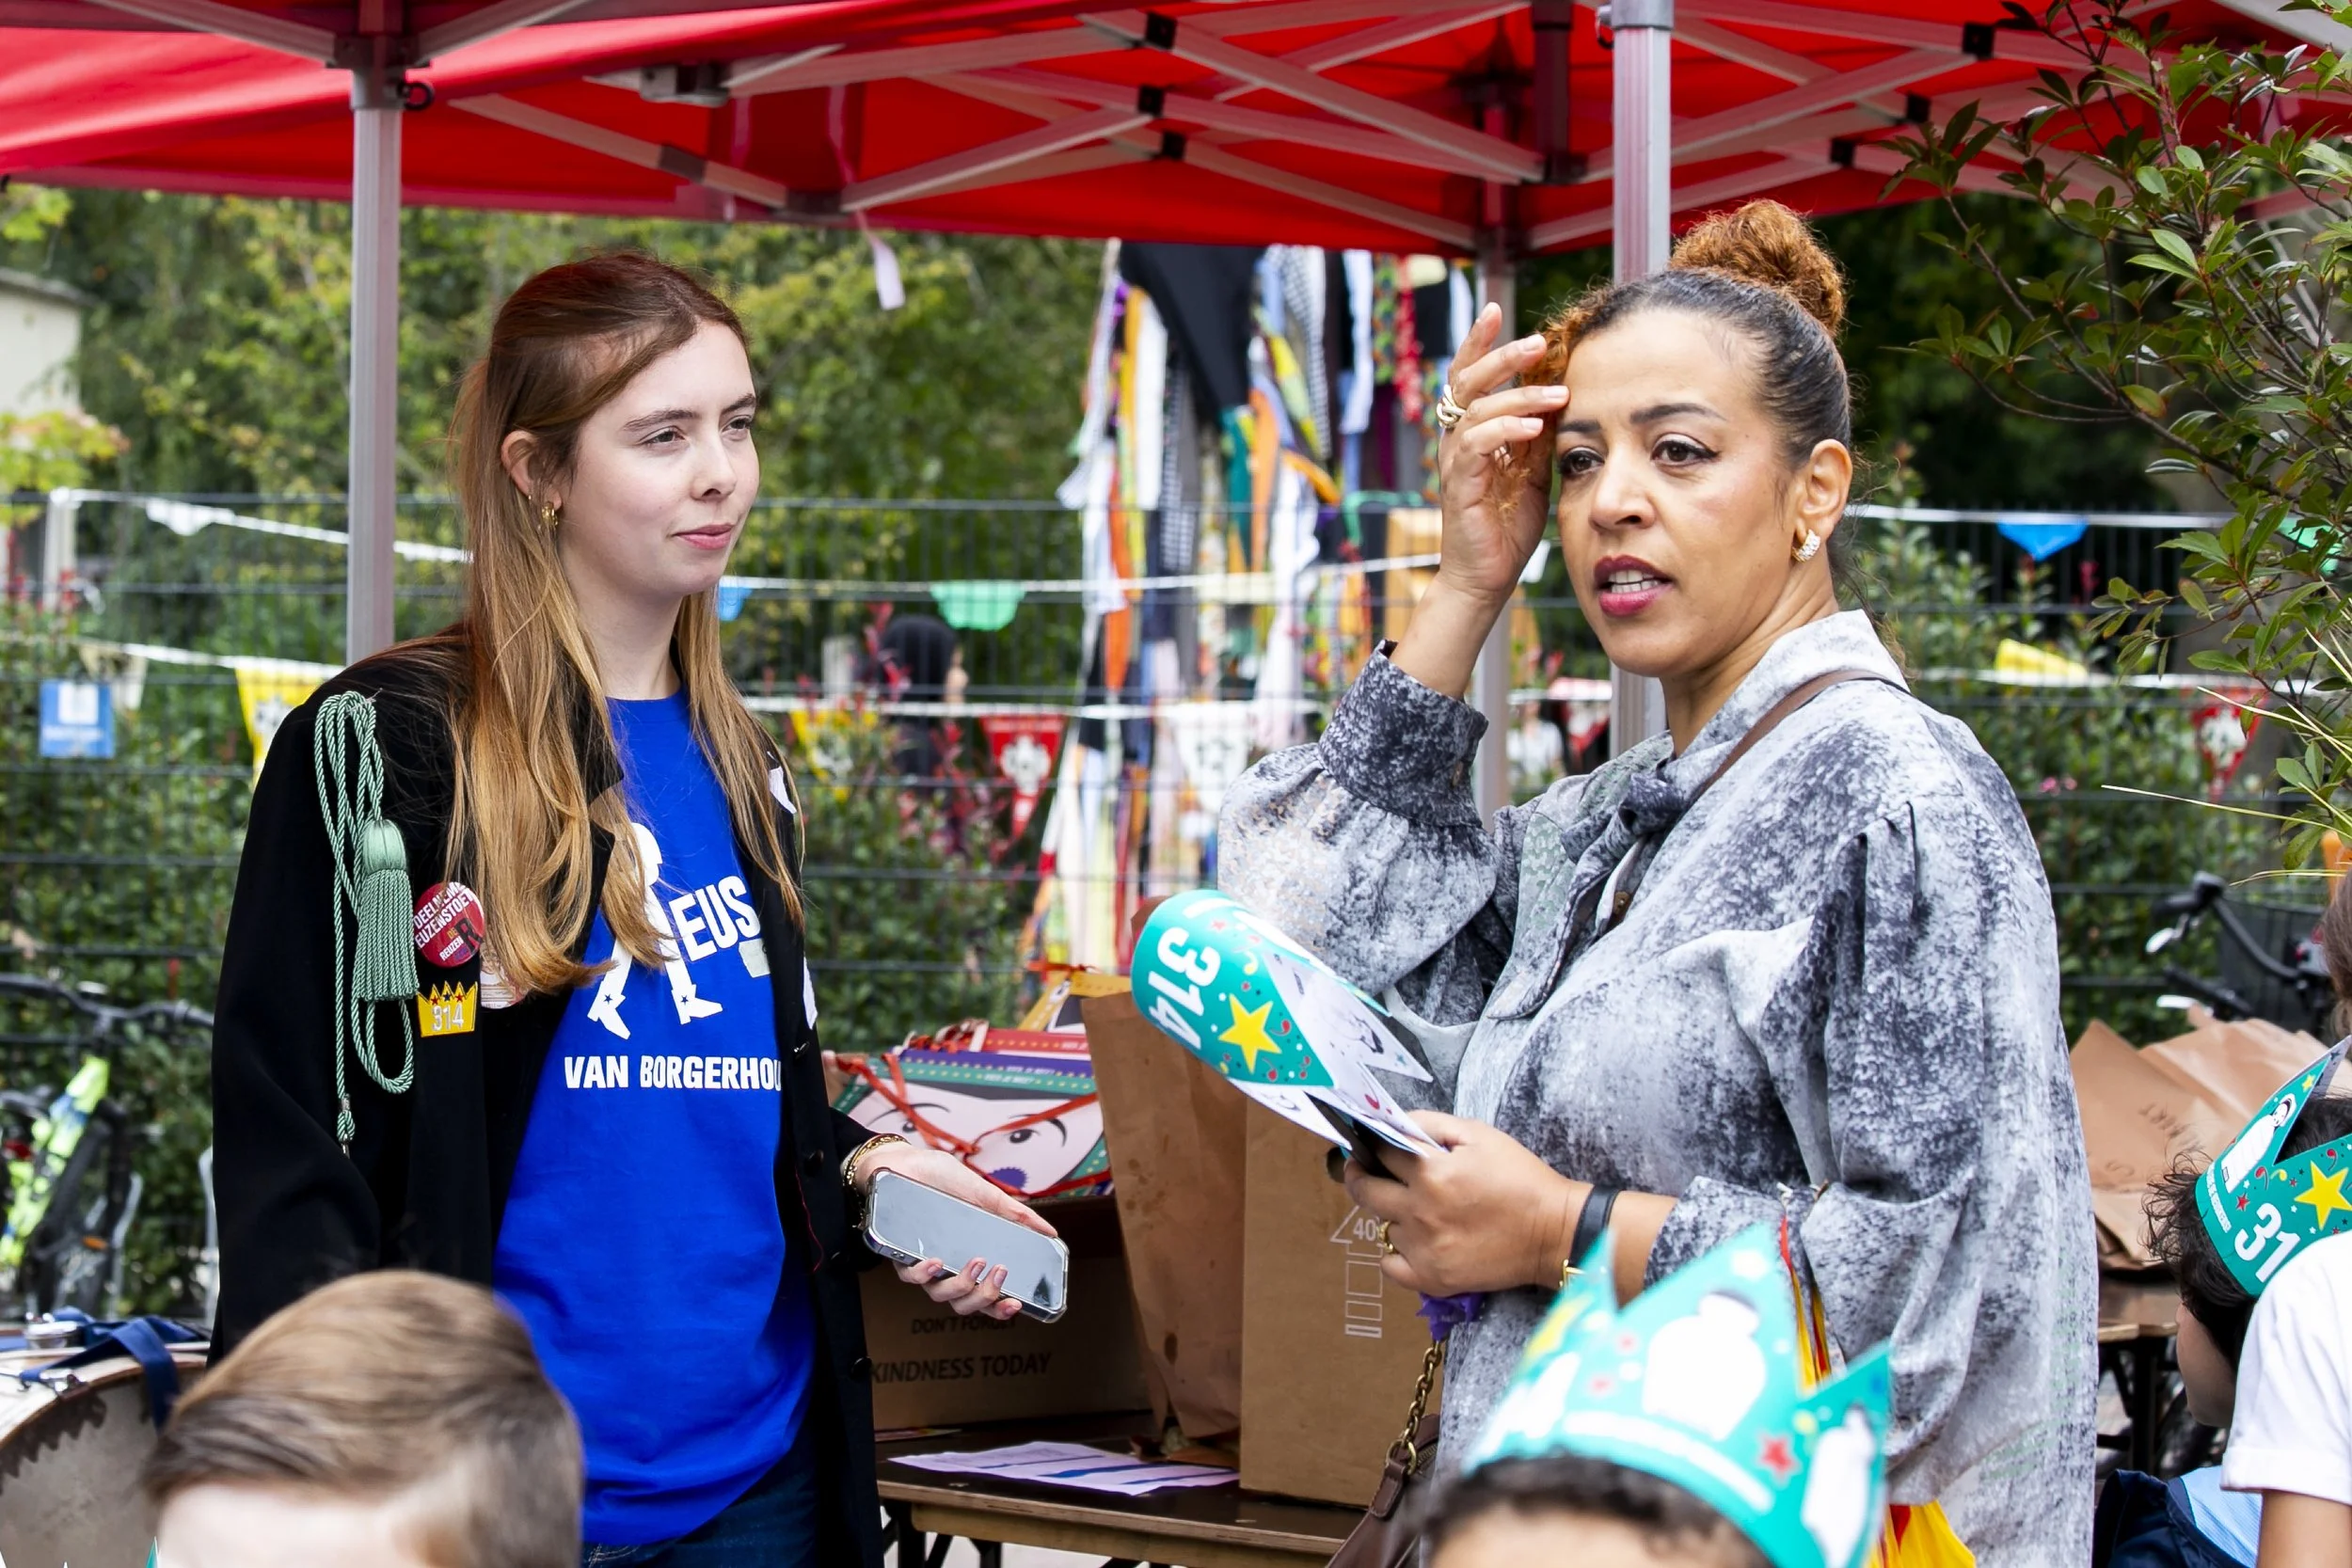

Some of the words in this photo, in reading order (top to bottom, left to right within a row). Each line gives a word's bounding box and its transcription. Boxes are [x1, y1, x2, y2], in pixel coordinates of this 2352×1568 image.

[438, 936, 464, 961] REUZEN
[1148, 927, 1221, 1050] 314
[432, 1006, 465, 1032] 314
[564, 1055, 628, 1088] VAN
[912, 1318, 961, 1335] DON'T
[871, 1356, 975, 1384] KINDNESS
[980, 1353, 1052, 1378] TODAY
